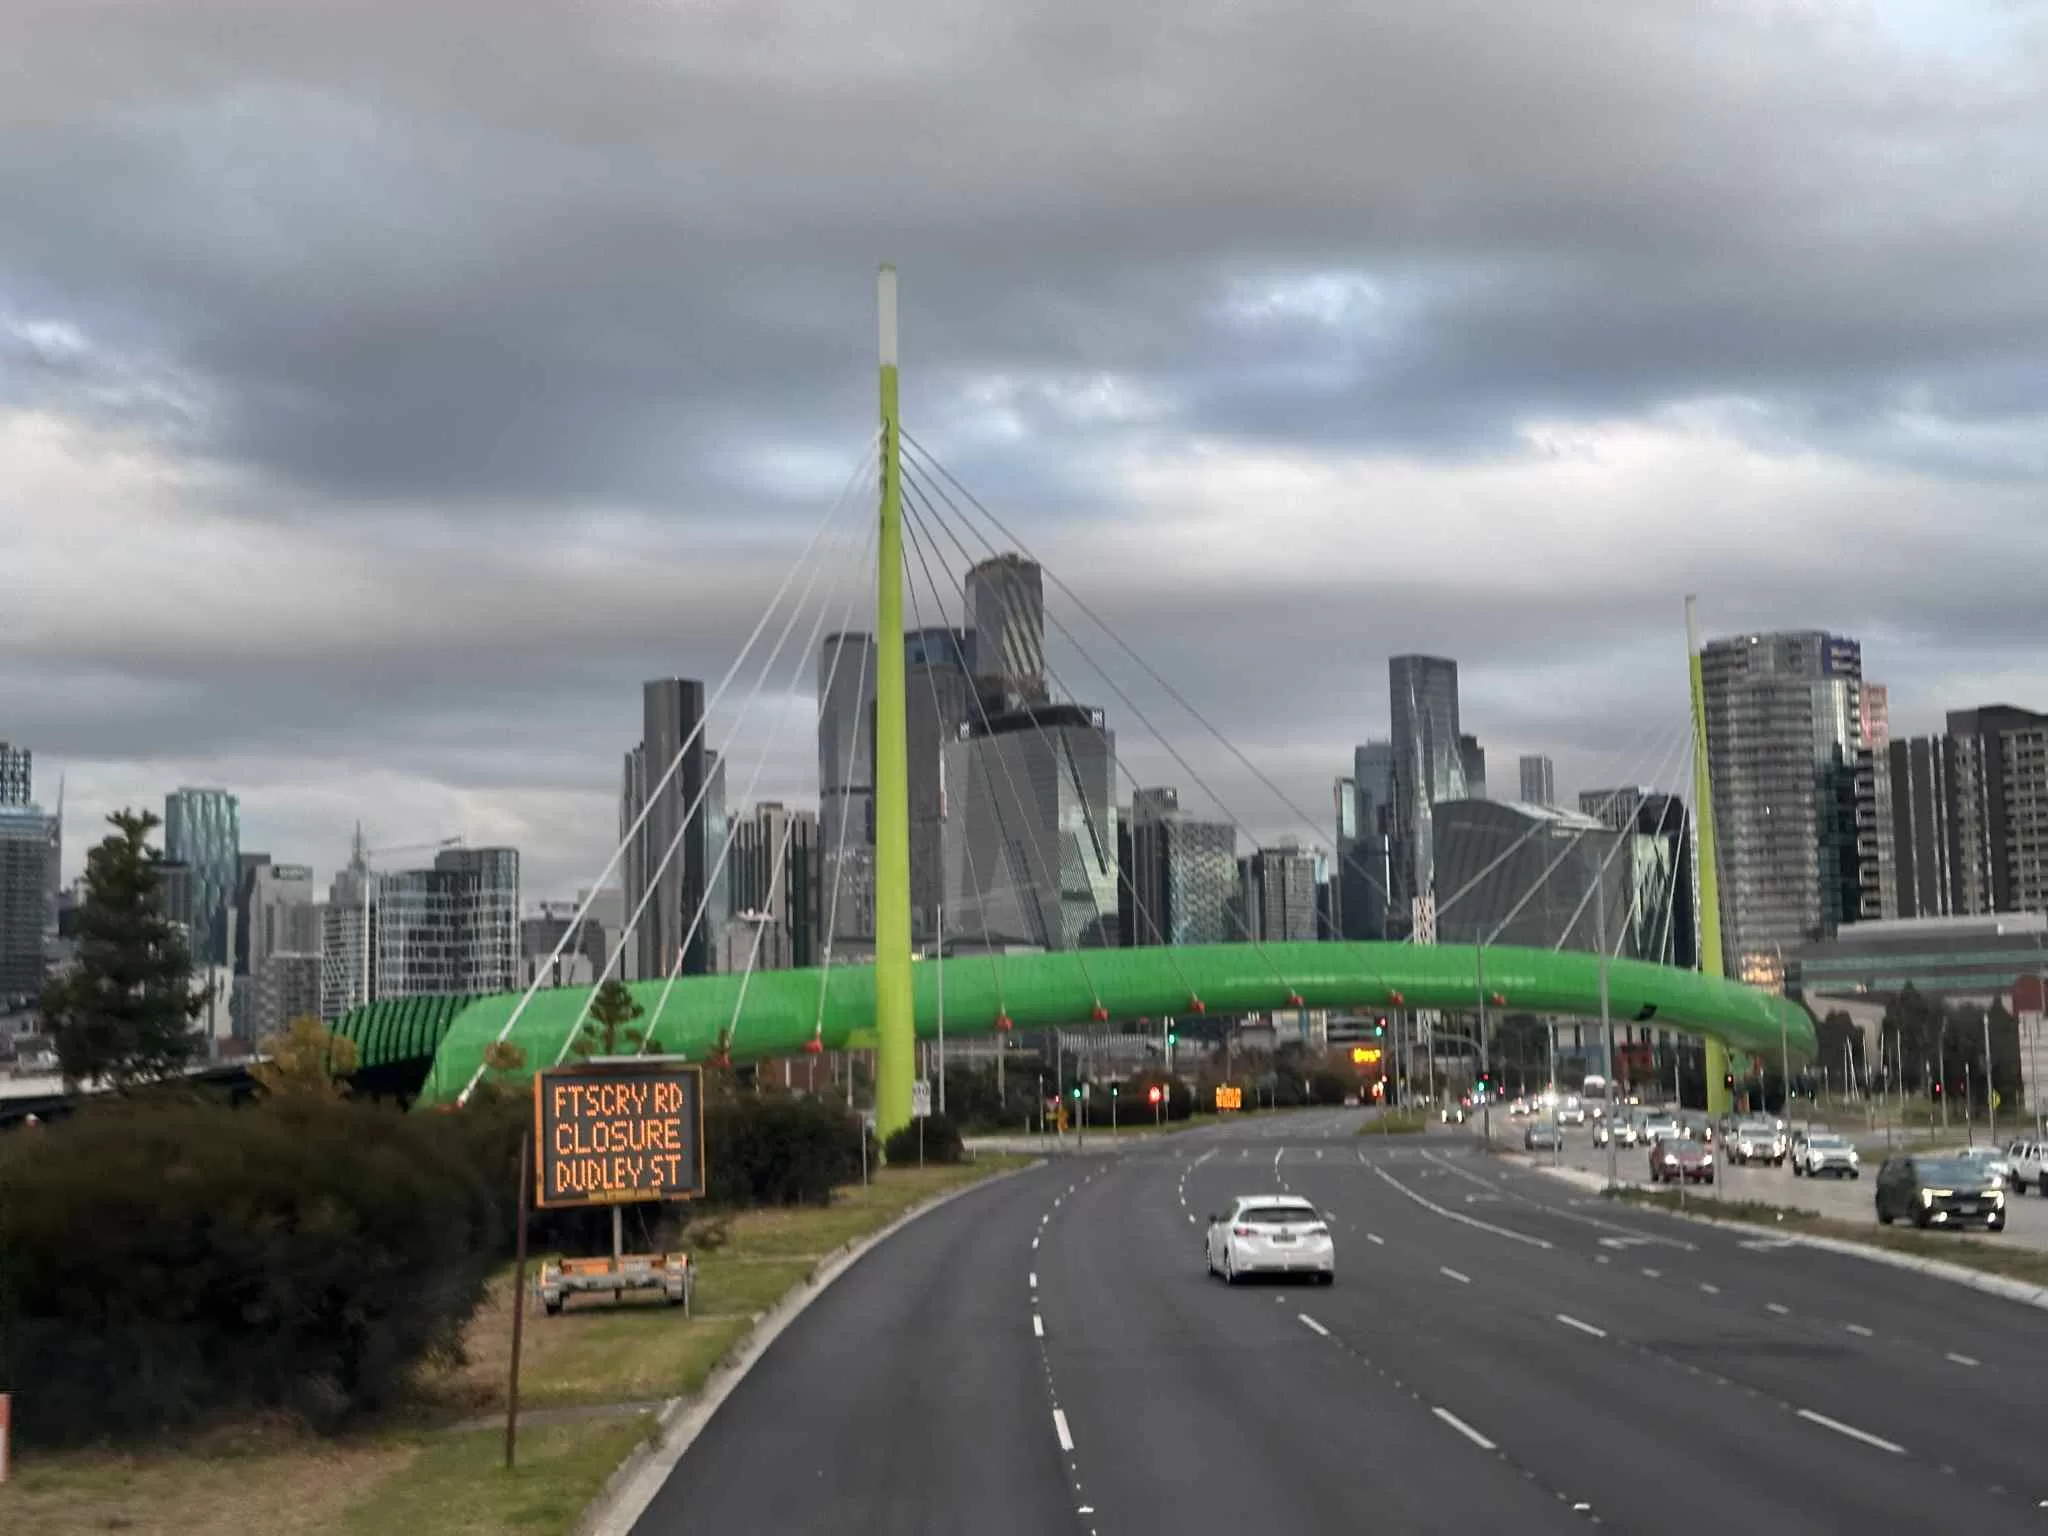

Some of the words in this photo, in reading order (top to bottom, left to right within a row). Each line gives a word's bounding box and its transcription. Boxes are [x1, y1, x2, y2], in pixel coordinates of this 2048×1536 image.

[555, 1083, 647, 1117] FTSCRY
[655, 1082, 683, 1113] RD
[556, 1118, 681, 1155] CLOSURE
[556, 1156, 643, 1192] DUDLEY
[651, 1154, 681, 1186] ST
